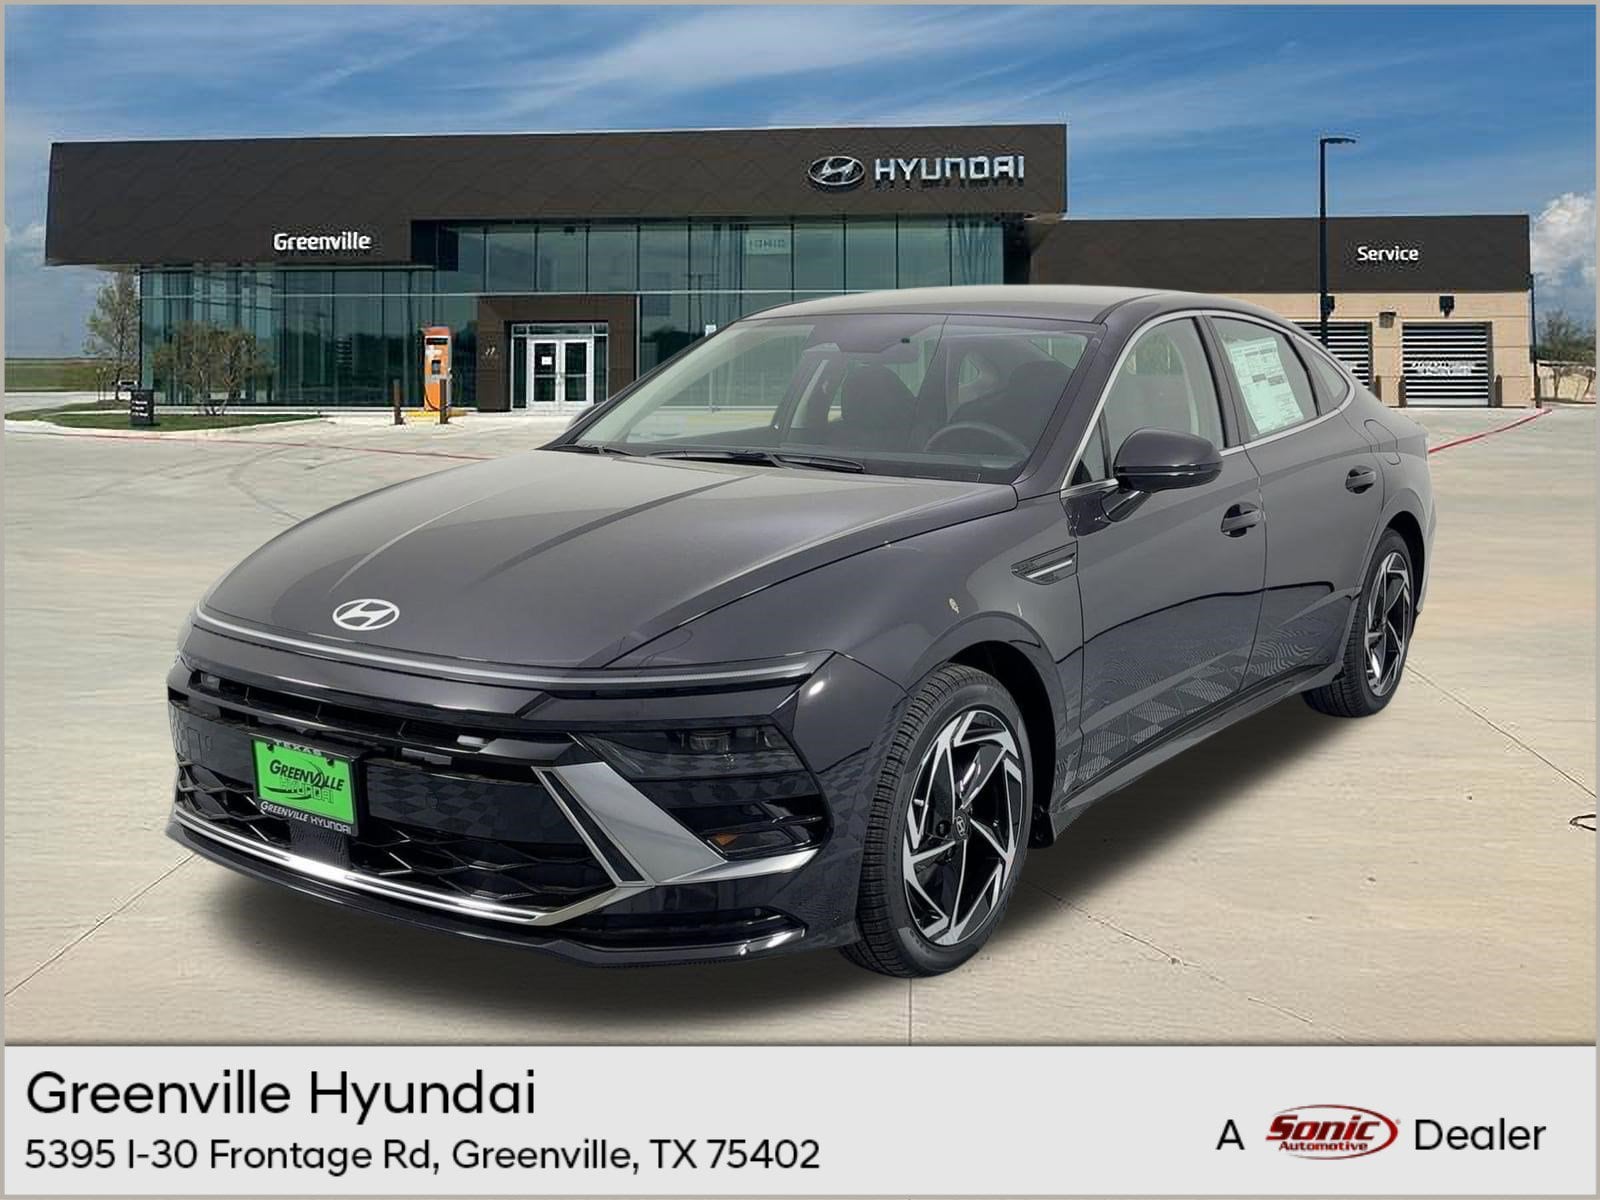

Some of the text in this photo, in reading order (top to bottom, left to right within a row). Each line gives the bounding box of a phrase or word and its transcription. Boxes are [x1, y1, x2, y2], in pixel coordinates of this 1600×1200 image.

[874, 155, 1025, 182] HYUNDAI
[273, 230, 372, 251] Greenville
[1356, 245, 1420, 262] Service
[269, 759, 345, 792] GREENVILLE
[260, 801, 352, 835] GREENVILLE HYUNDAI
